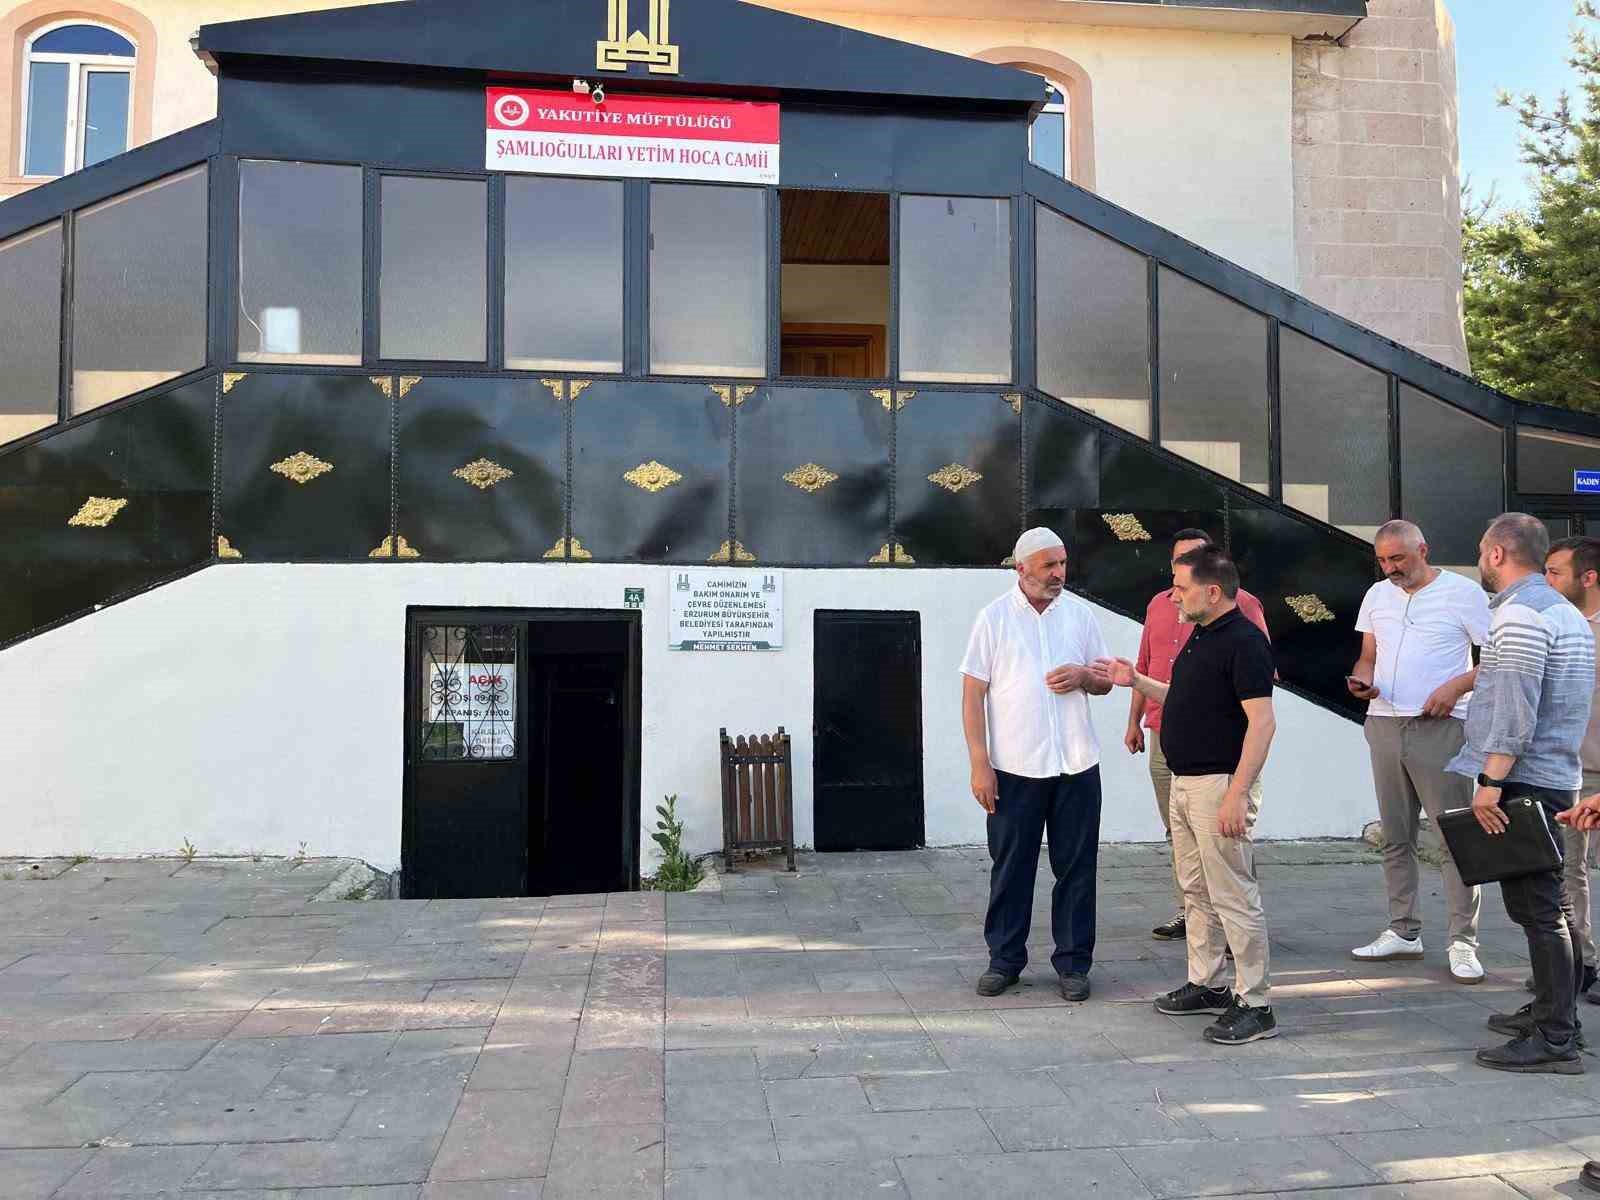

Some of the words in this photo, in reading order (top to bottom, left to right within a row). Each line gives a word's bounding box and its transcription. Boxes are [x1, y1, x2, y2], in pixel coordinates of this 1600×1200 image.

[537, 108, 622, 124] YAKUTİYE
[627, 112, 732, 129] MÜFTÜLÜĞÜ
[496, 139, 622, 161] ŞAMLIOĞULLARI
[627, 144, 674, 163] YETİM
[680, 148, 721, 166] HOCA
[725, 150, 768, 168] CAMİİ
[707, 580, 747, 589] CAMİMİZİN
[720, 591, 749, 599] ONARIM
[751, 591, 761, 599] VE
[688, 601, 712, 609] ÇEVRE
[714, 600, 766, 609] DÜZENLEMESİ
[722, 610, 769, 619] BÜYÜKŞEHİR
[680, 620, 723, 628] BELEDİYESİ
[725, 621, 774, 629] TARAFINDAN
[702, 630, 751, 639] YAPILMIŞTIR
